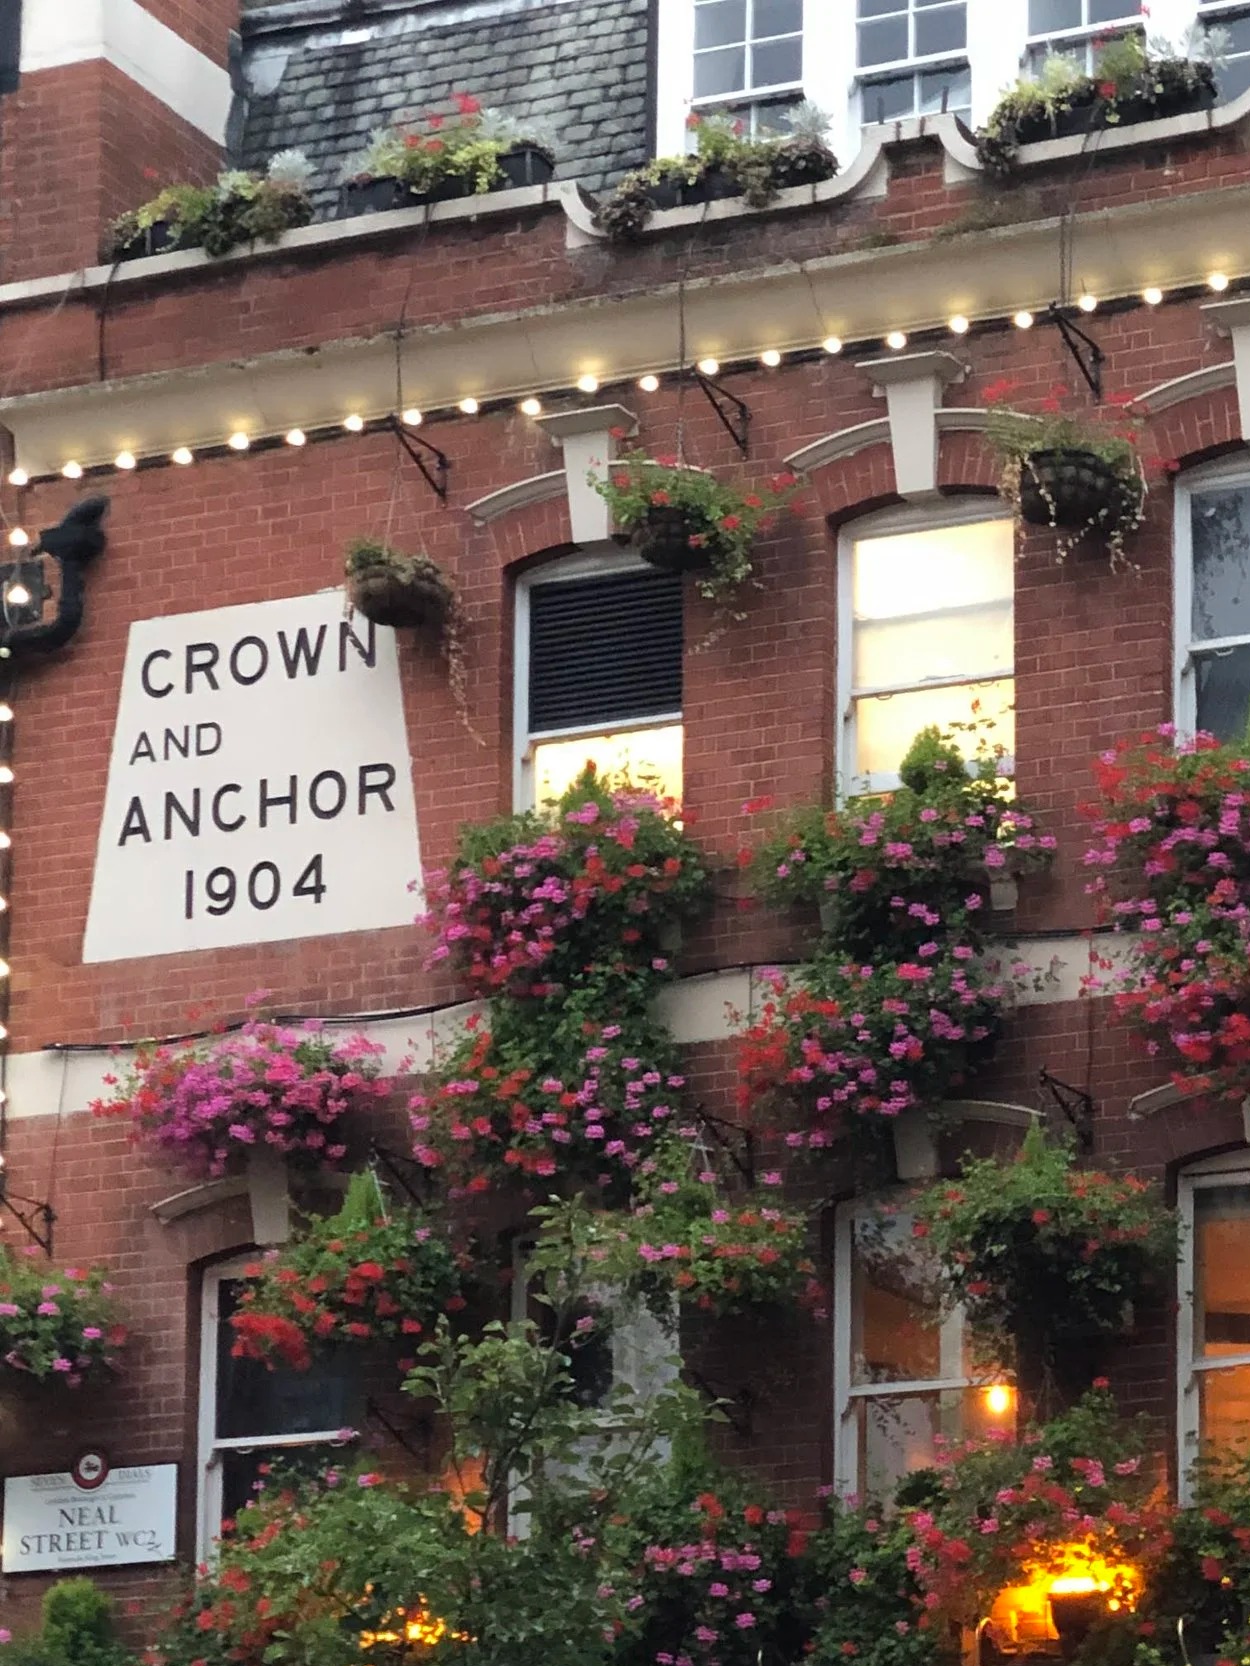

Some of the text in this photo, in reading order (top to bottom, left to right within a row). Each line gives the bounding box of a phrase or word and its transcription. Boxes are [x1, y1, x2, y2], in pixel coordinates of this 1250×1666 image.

[141, 621, 377, 699] CROWN
[129, 721, 222, 765] AND
[117, 762, 396, 847] ANCHOR
[185, 853, 326, 920] 1904
[20, 1530, 157, 1555] STREET WC2
[58, 1505, 120, 1528] NEAL
